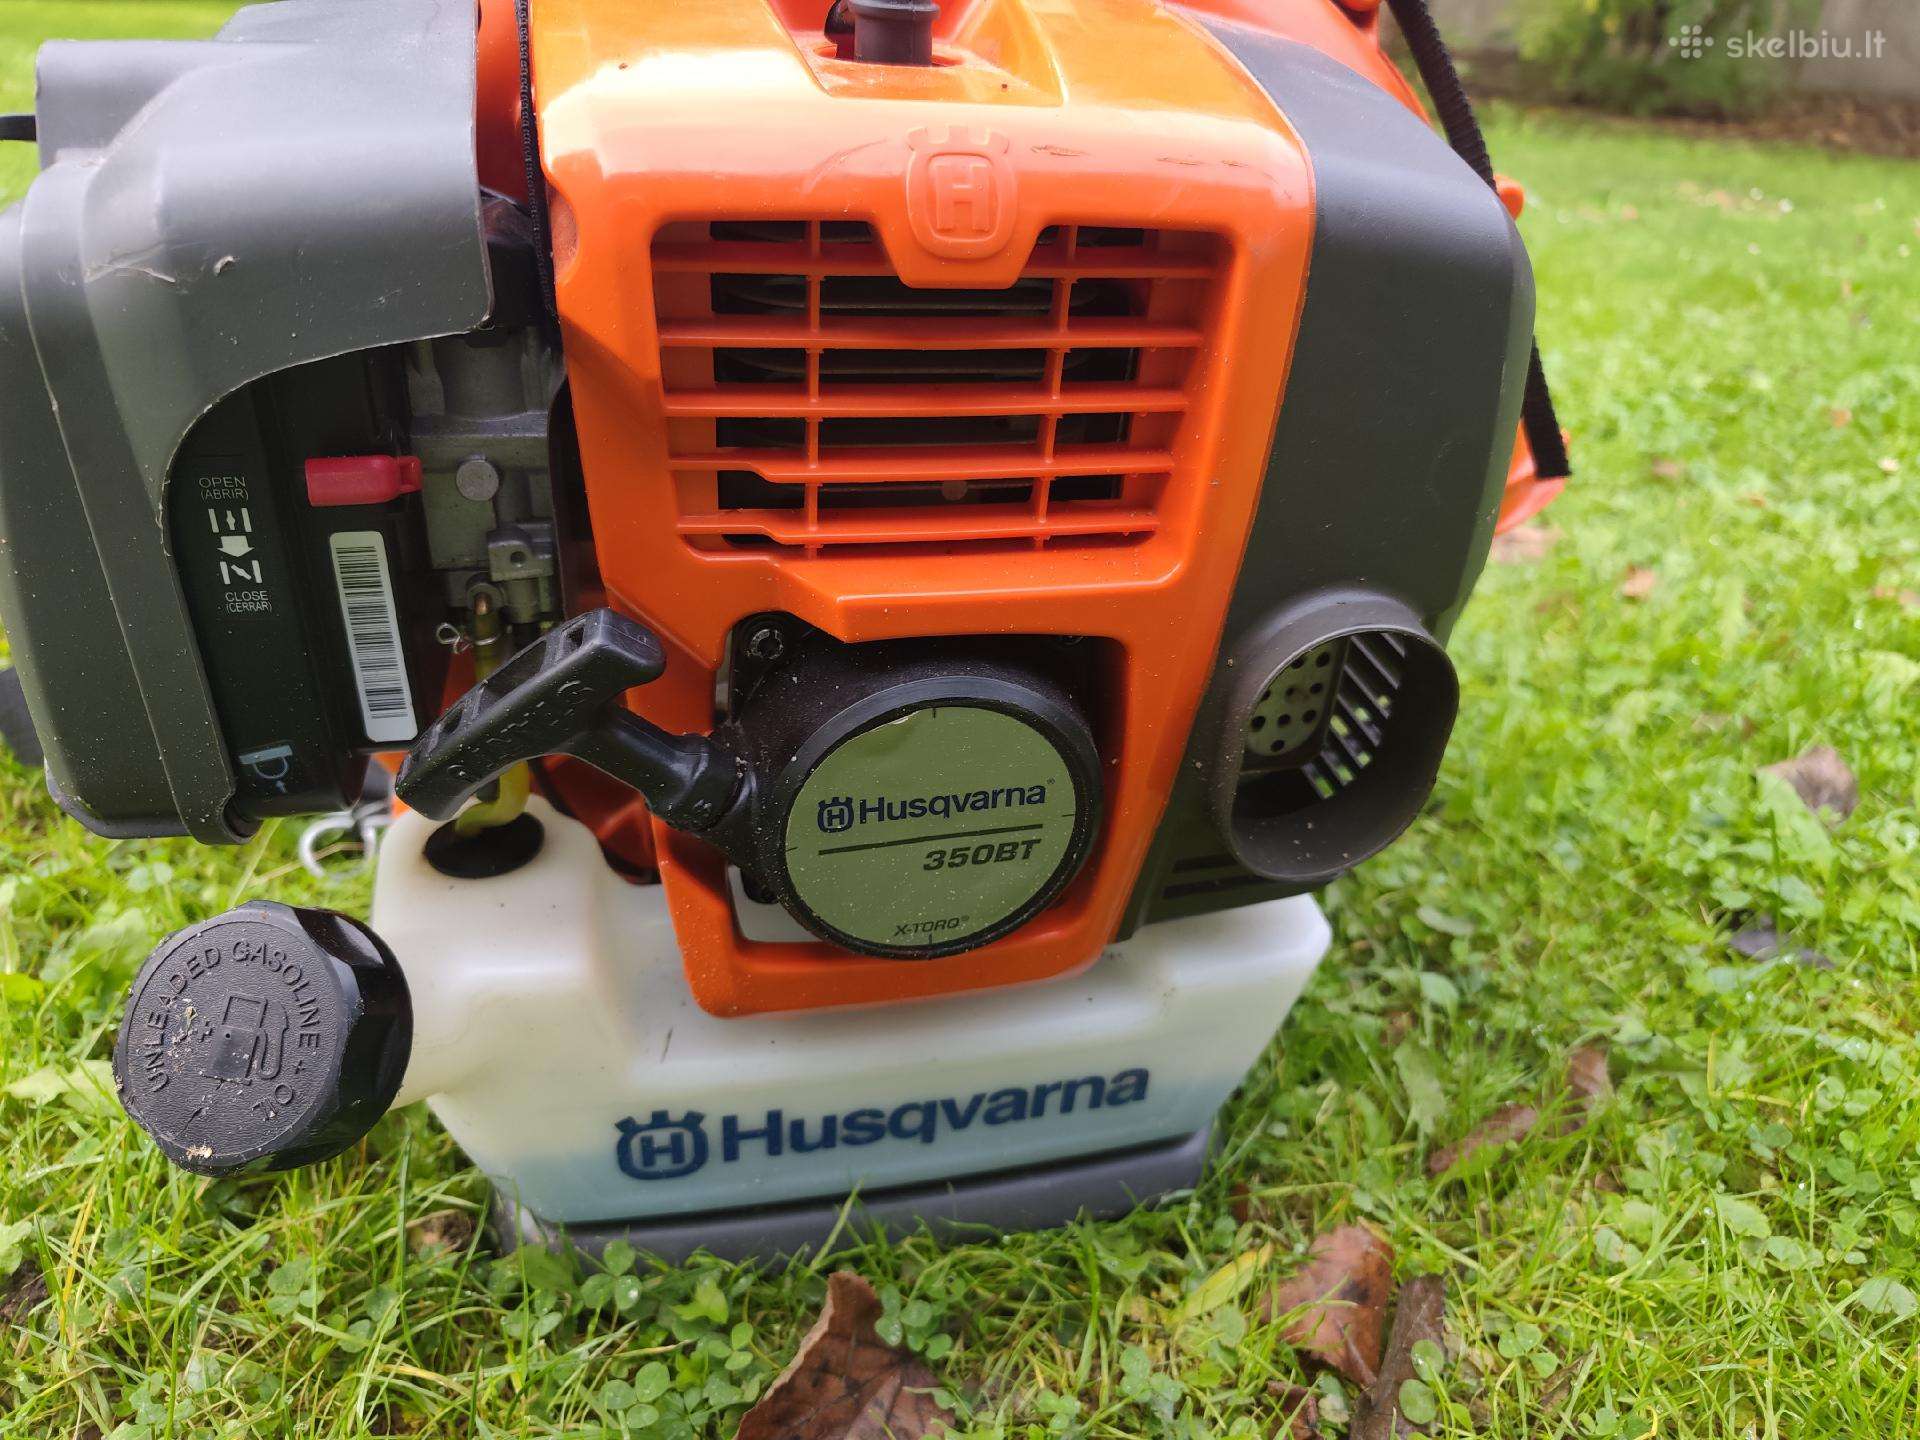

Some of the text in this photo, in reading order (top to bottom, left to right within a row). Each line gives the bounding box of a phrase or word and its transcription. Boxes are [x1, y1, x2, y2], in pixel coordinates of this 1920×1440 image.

[199, 476, 246, 488] OPEN
[200, 488, 249, 500] (ABRIR)
[225, 590, 268, 602] CLOSE
[226, 602, 272, 613] (CERRAR)
[859, 785, 1046, 824] Husqvarna
[923, 838, 1041, 871] 350BT
[145, 945, 222, 1093] UNLEADED
[232, 941, 321, 1049] GASOLINE
[722, 1067, 1149, 1162] Husqvarna
